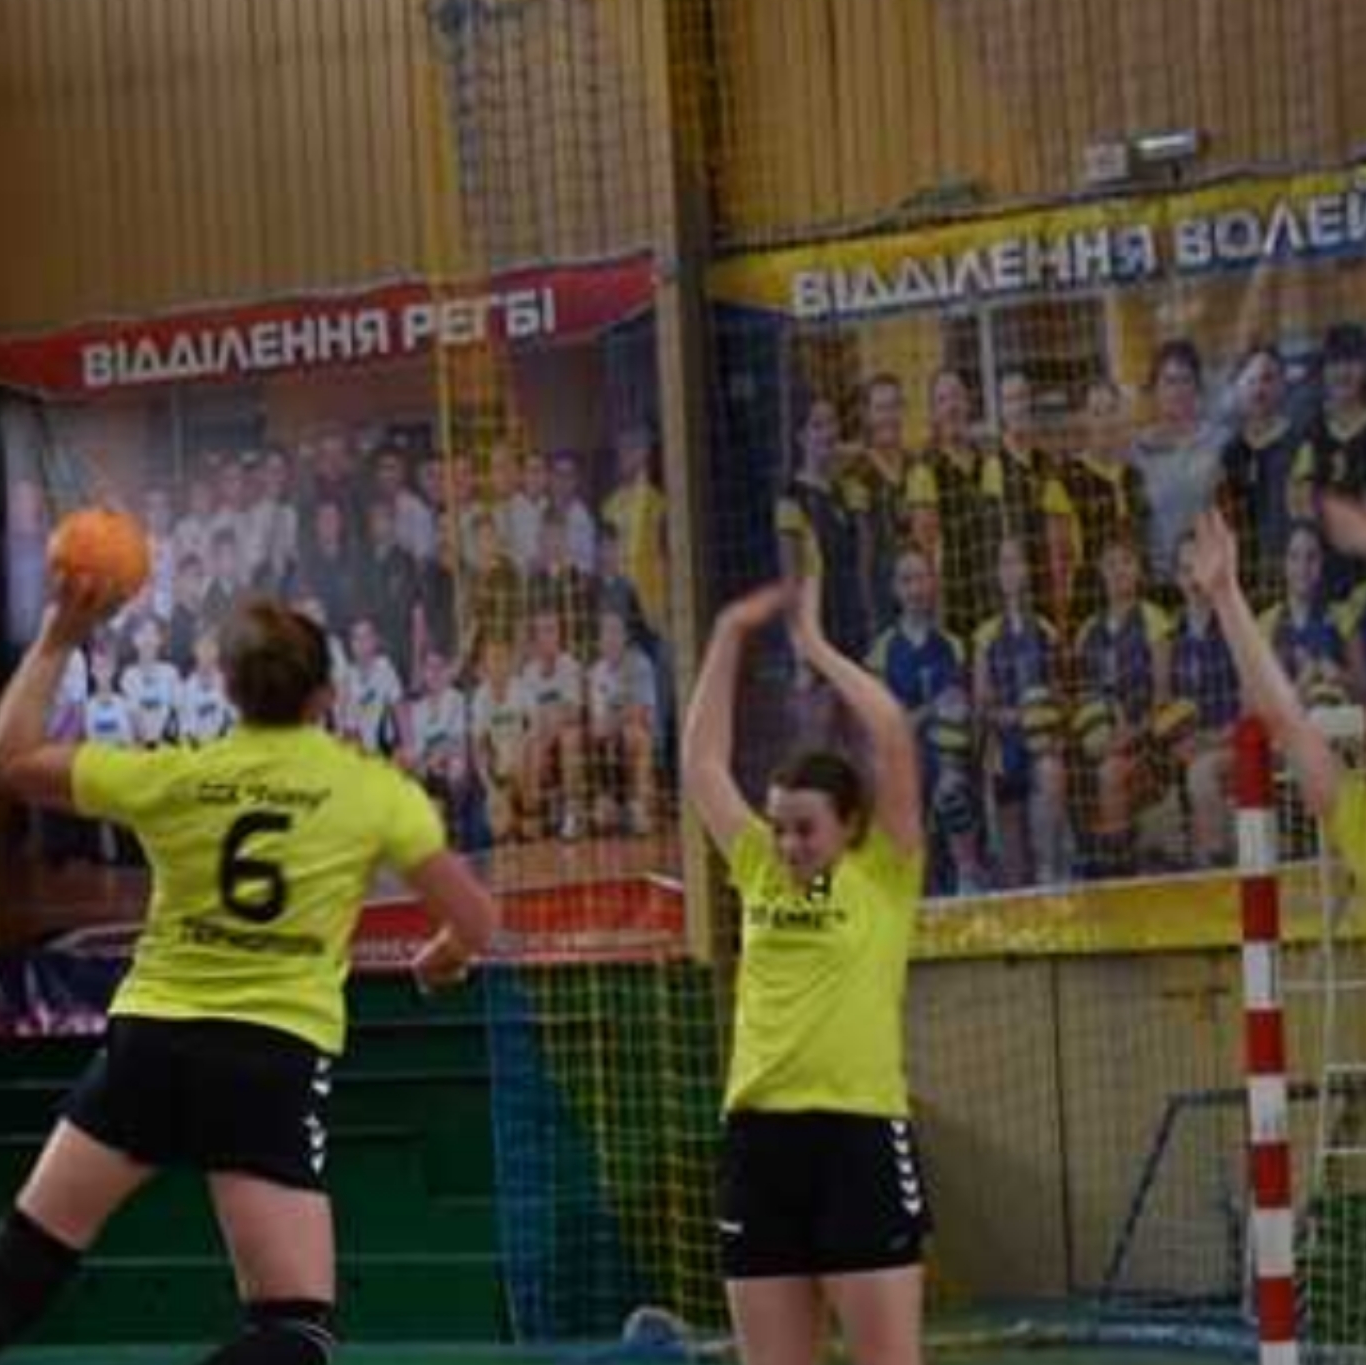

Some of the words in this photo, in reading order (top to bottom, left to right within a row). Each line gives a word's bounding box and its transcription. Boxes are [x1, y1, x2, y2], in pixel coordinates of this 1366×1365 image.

[789, 222, 1157, 318] ВІДДІЛЕННЯ
[82, 307, 391, 389] ВІДДІЛЕННЯ
[400, 286, 557, 352] РЕГБІ
[219, 808, 293, 923] 6
